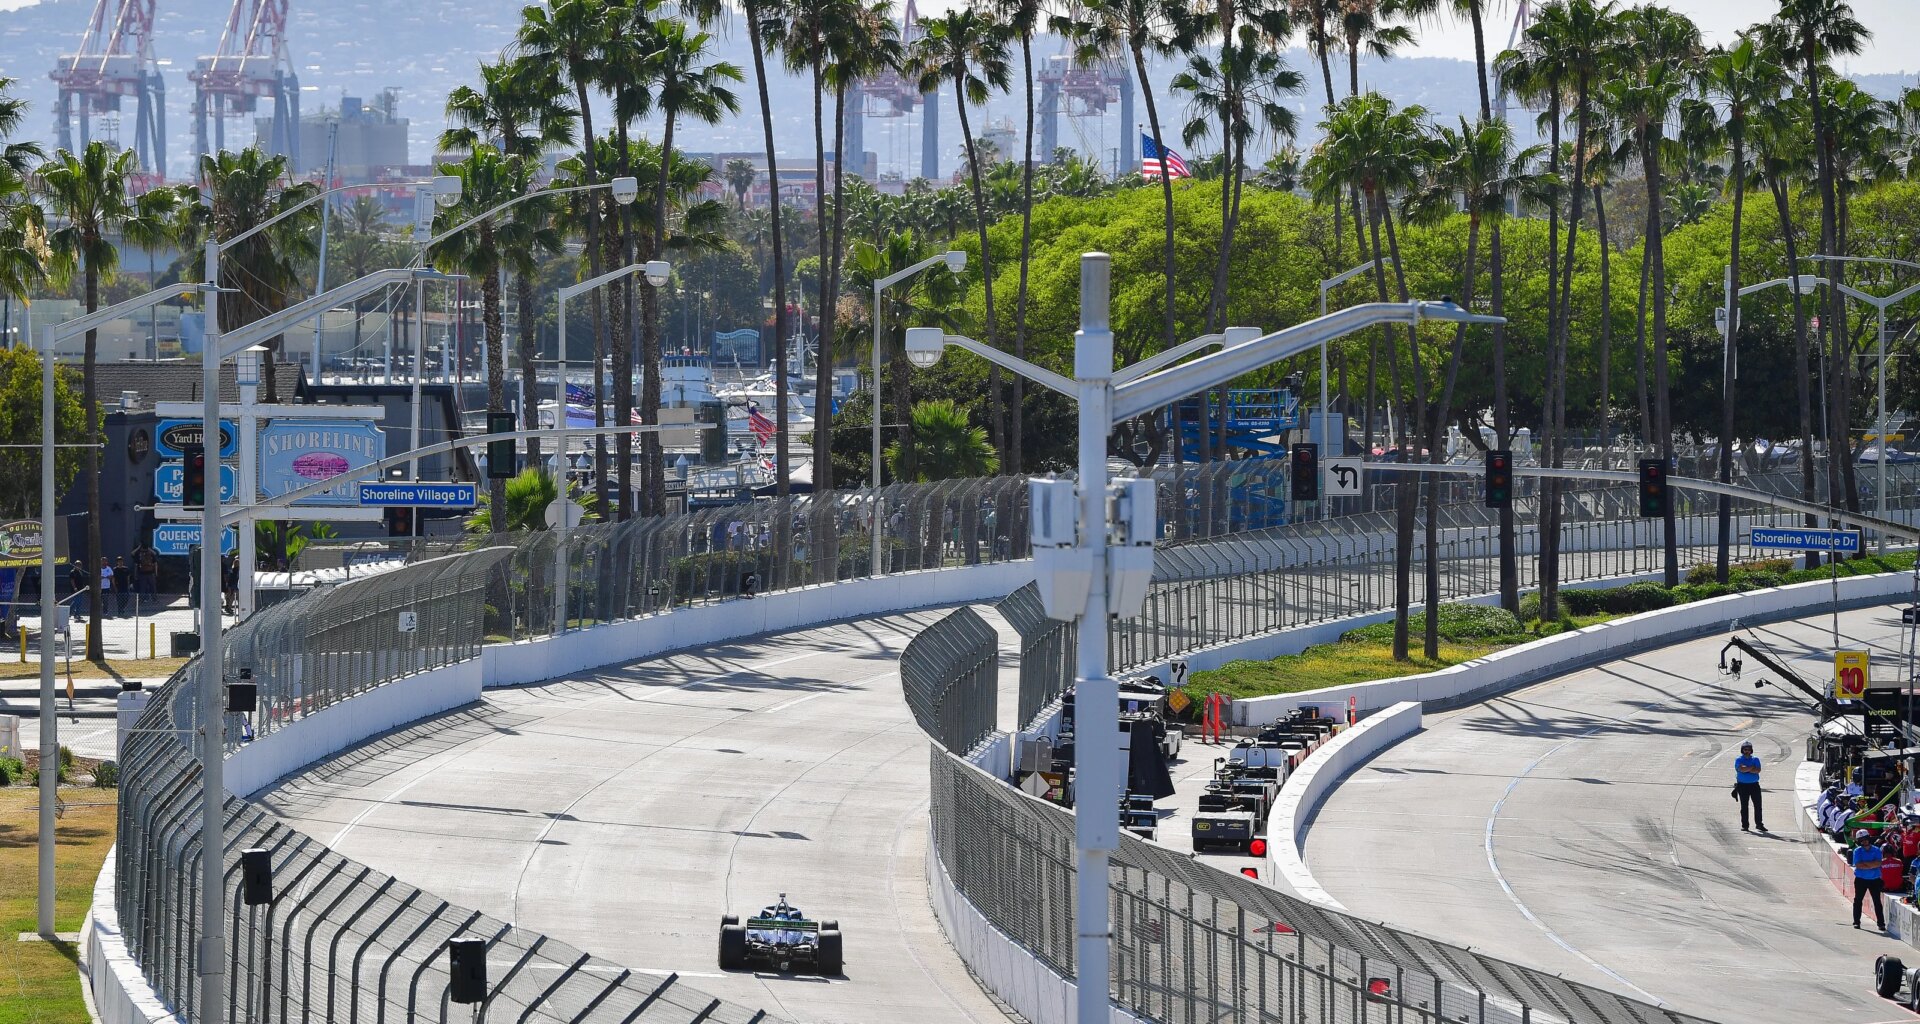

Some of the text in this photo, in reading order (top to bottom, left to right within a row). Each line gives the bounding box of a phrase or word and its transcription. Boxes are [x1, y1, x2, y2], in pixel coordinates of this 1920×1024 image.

[172, 433, 192, 443] Yard
[269, 432, 374, 459] SHORELINE
[362, 488, 472, 503] Shoreline Village Dr
[1753, 532, 1802, 544] Shoreline
[1842, 536, 1855, 546] Dr
[1839, 667, 1865, 695] 10
[1868, 708, 1897, 716] verizon
